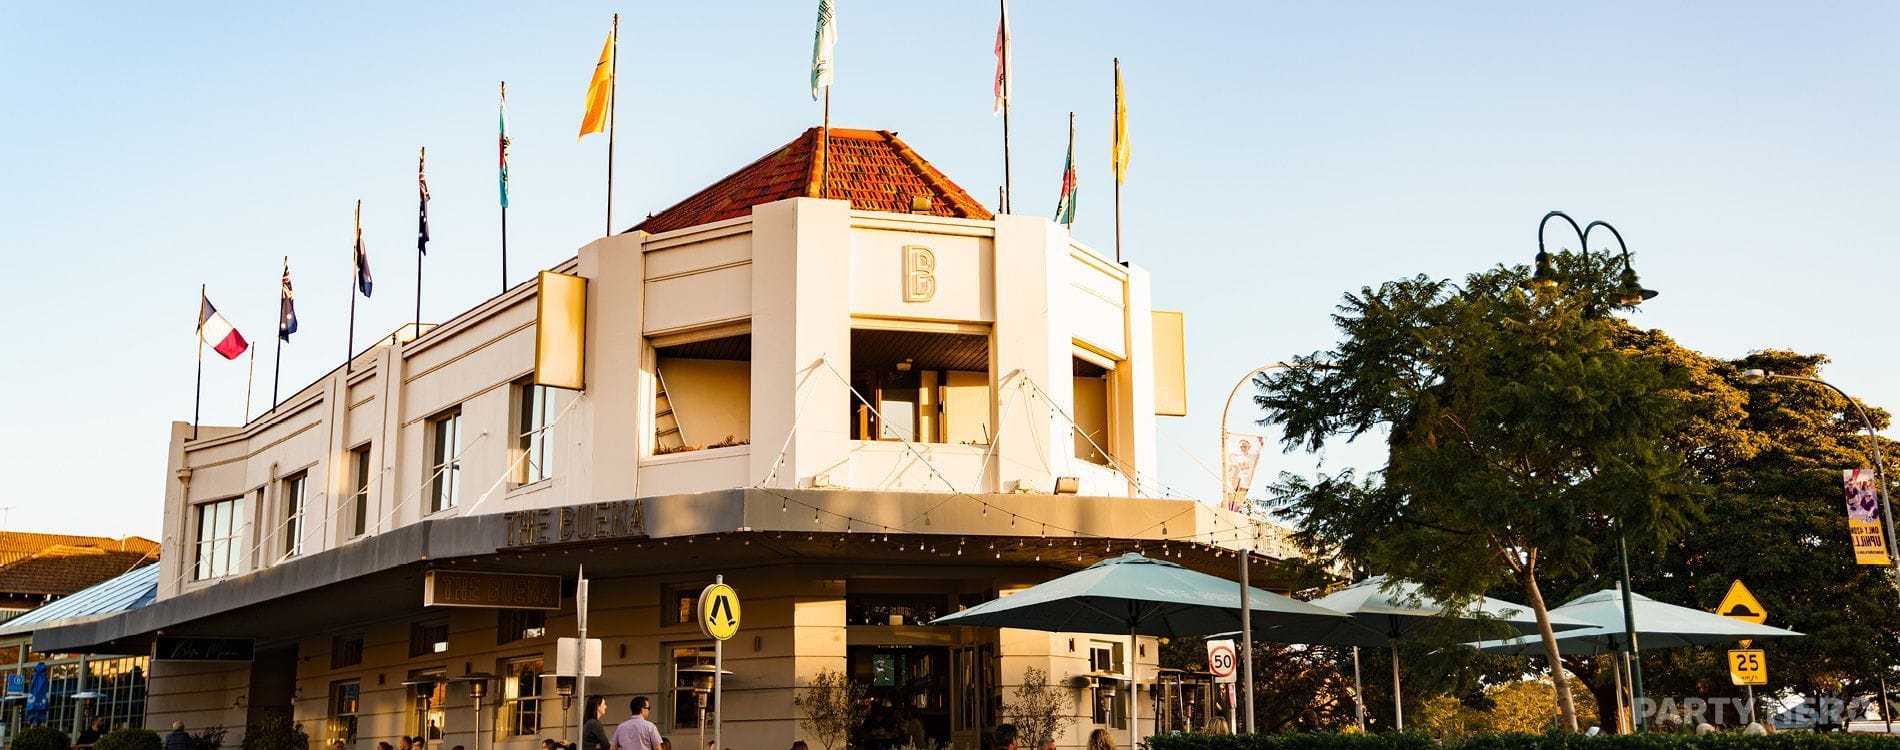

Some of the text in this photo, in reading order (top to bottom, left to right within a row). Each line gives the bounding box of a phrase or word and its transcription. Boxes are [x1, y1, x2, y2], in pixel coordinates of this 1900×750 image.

[901, 244, 936, 303] B
[504, 500, 645, 546] THE BUENA
[442, 577, 554, 604] THE BUENA
[1214, 655, 1232, 668] 50
[1736, 654, 1759, 671] 25
